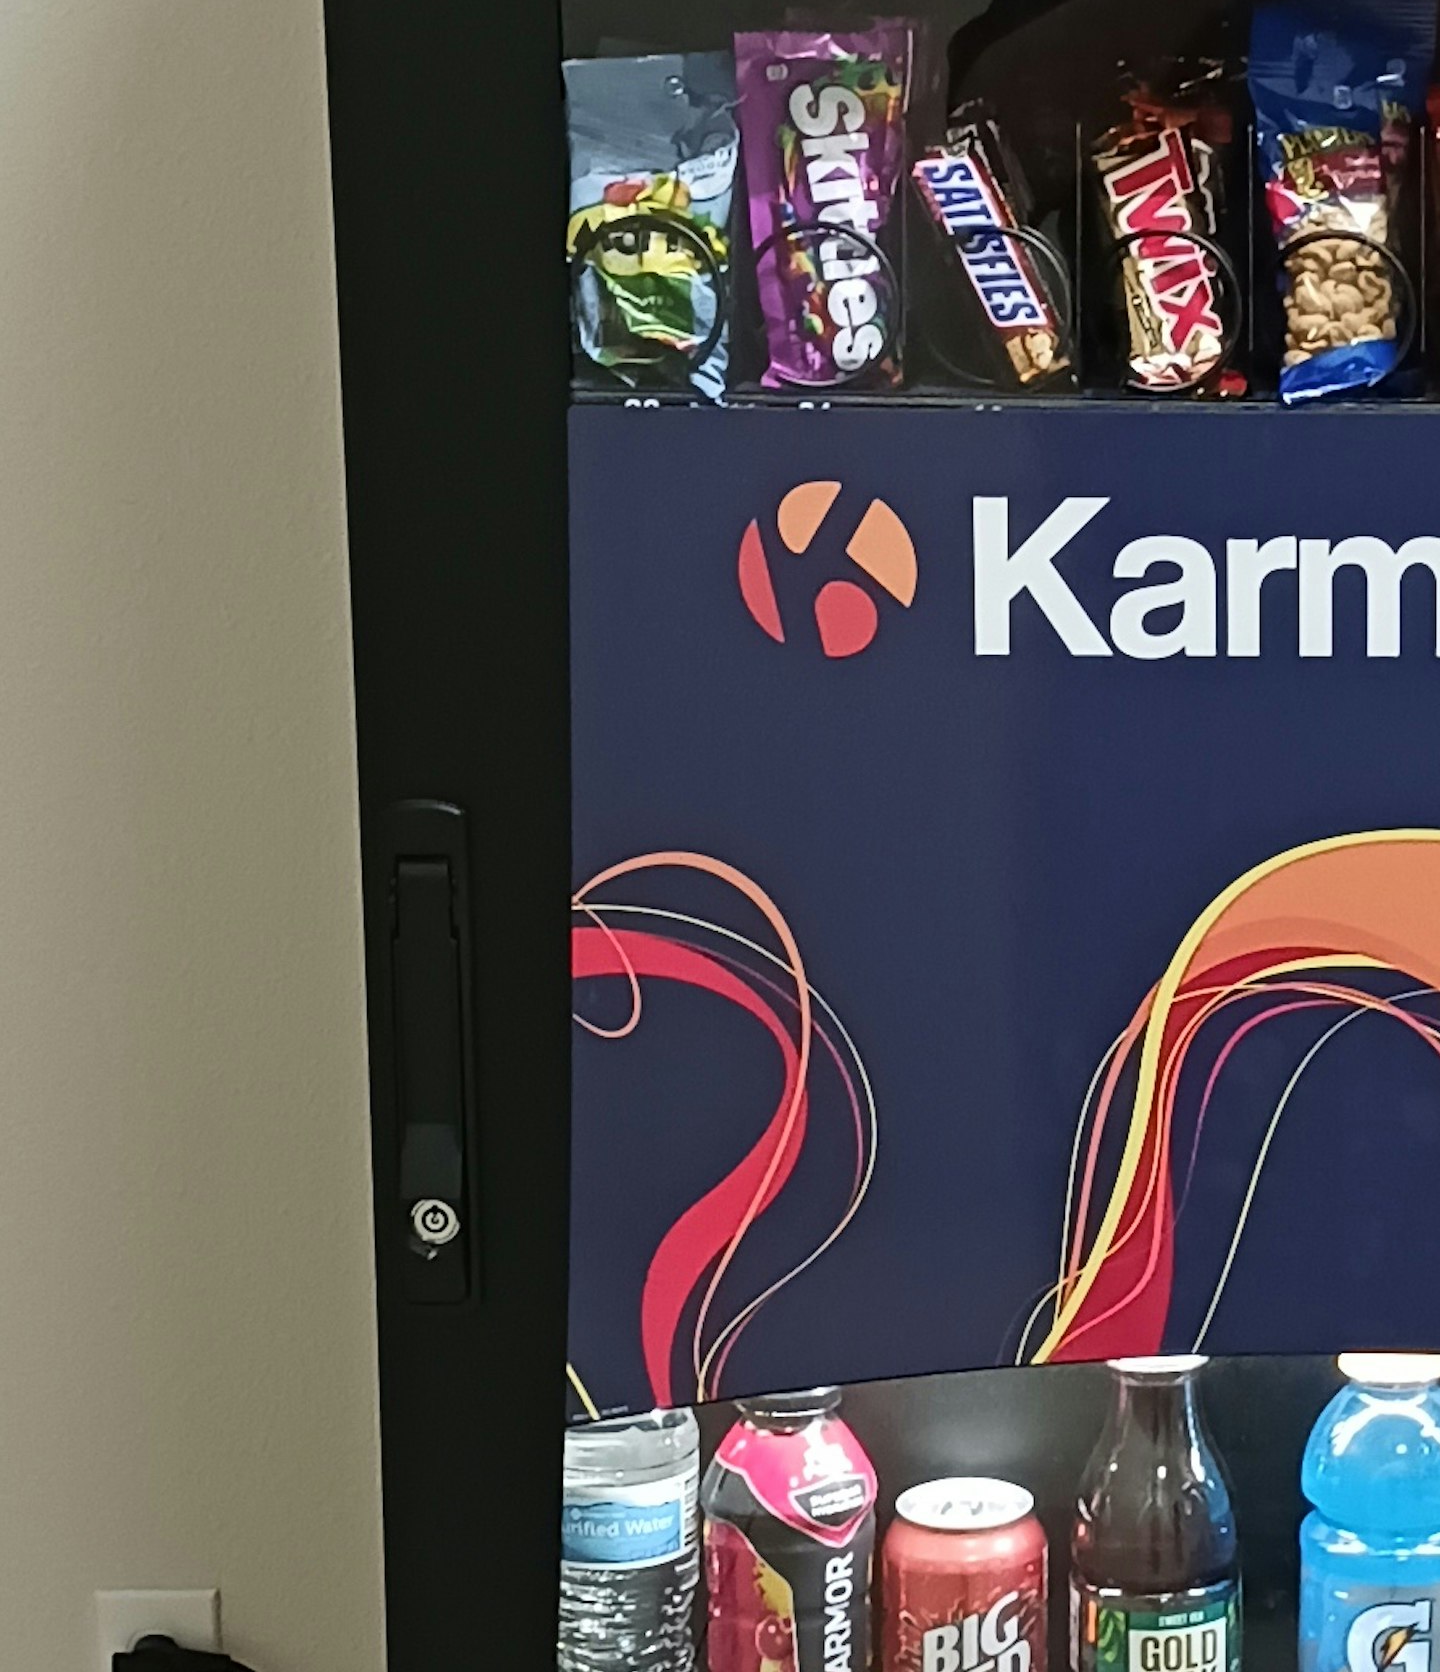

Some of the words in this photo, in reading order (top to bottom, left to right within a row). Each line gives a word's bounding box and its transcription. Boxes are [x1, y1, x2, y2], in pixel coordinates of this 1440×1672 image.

[927, 160, 1042, 325] SATSFIES
[624, 1514, 675, 1536] Water
[1141, 1629, 1217, 1672] GOLD
